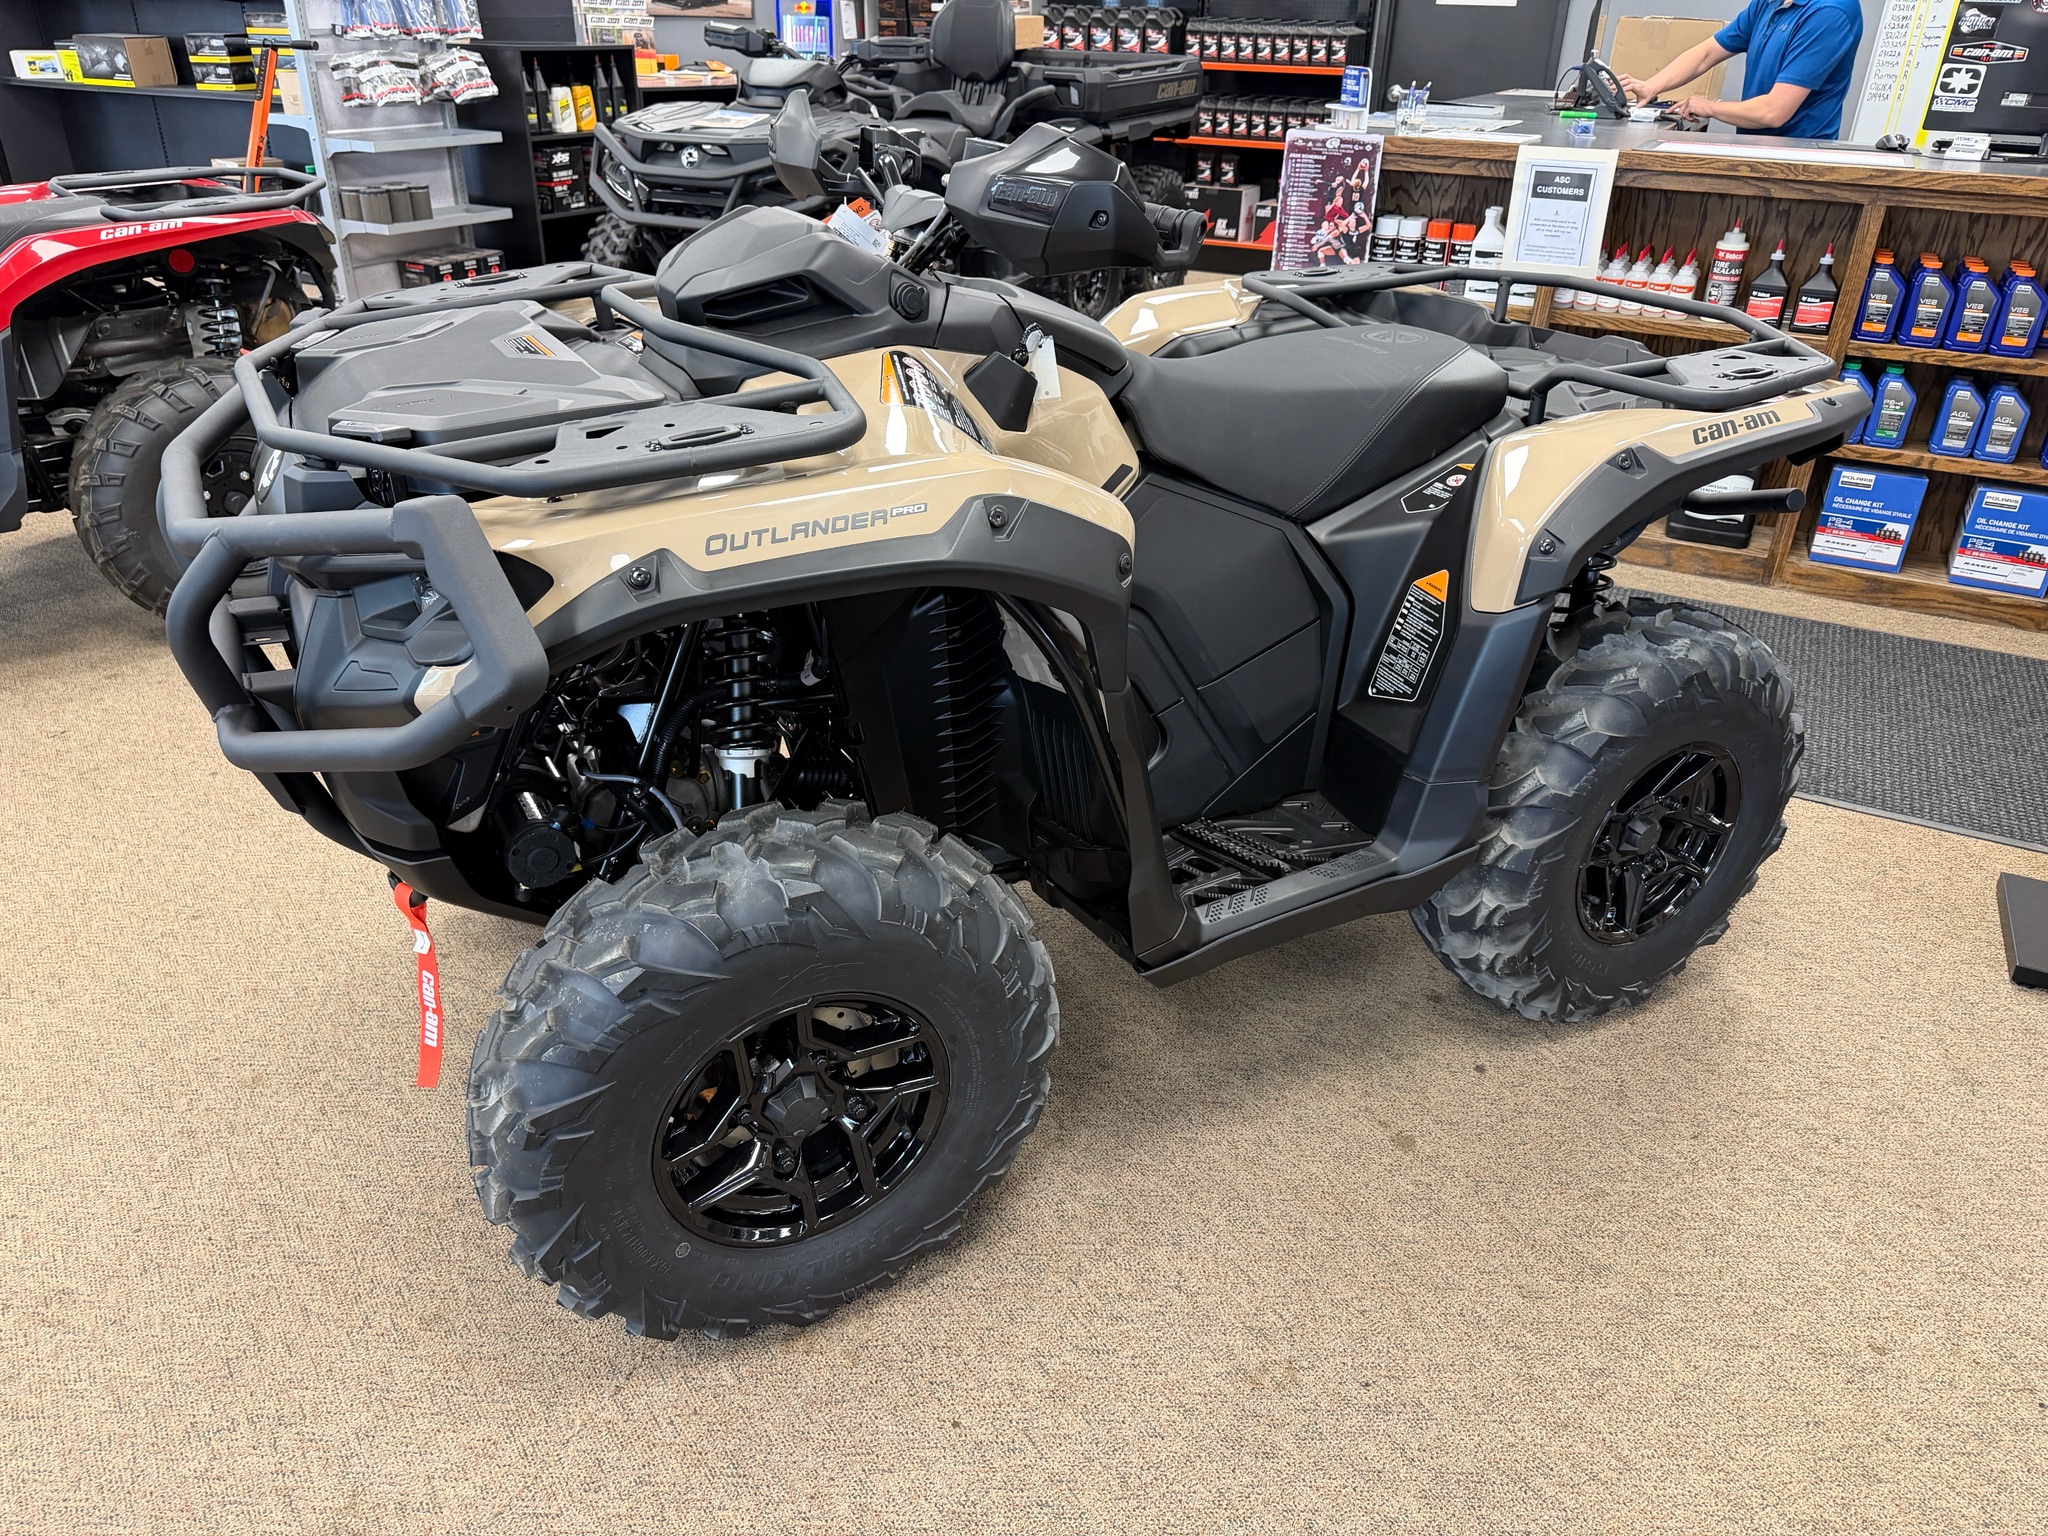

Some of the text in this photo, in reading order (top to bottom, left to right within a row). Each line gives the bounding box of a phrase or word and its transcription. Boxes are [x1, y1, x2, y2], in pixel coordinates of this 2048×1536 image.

[1962, 48, 2014, 58] can-am
[1157, 79, 1197, 99] can-am
[1945, 98, 1976, 107] CMC
[552, 152, 570, 164] XPS
[1554, 175, 1571, 183] ASC
[1536, 185, 1585, 196] CUSTOMERS
[100, 220, 183, 240] can-am
[1725, 252, 1743, 260] Bobcat
[1713, 267, 1743, 275] SEALANT
[1950, 410, 1971, 418] AGL
[1994, 416, 2015, 424] AGL
[1692, 410, 1781, 445] can-am
[1841, 475, 1873, 483] POLARIS
[1845, 498, 1872, 507] CHANGE
[1986, 495, 2019, 504] POLARIS
[1832, 502, 1862, 512] NÉCESSAIRE
[1871, 508, 1892, 516] VIDANGE
[1989, 519, 2017, 530] CHANGE
[704, 503, 925, 557] OUTLANDER PRO
[1975, 524, 2007, 534] NÉCESSAIRE
[2016, 530, 2038, 539] VIDANGE
[422, 969, 439, 1048] can-am
